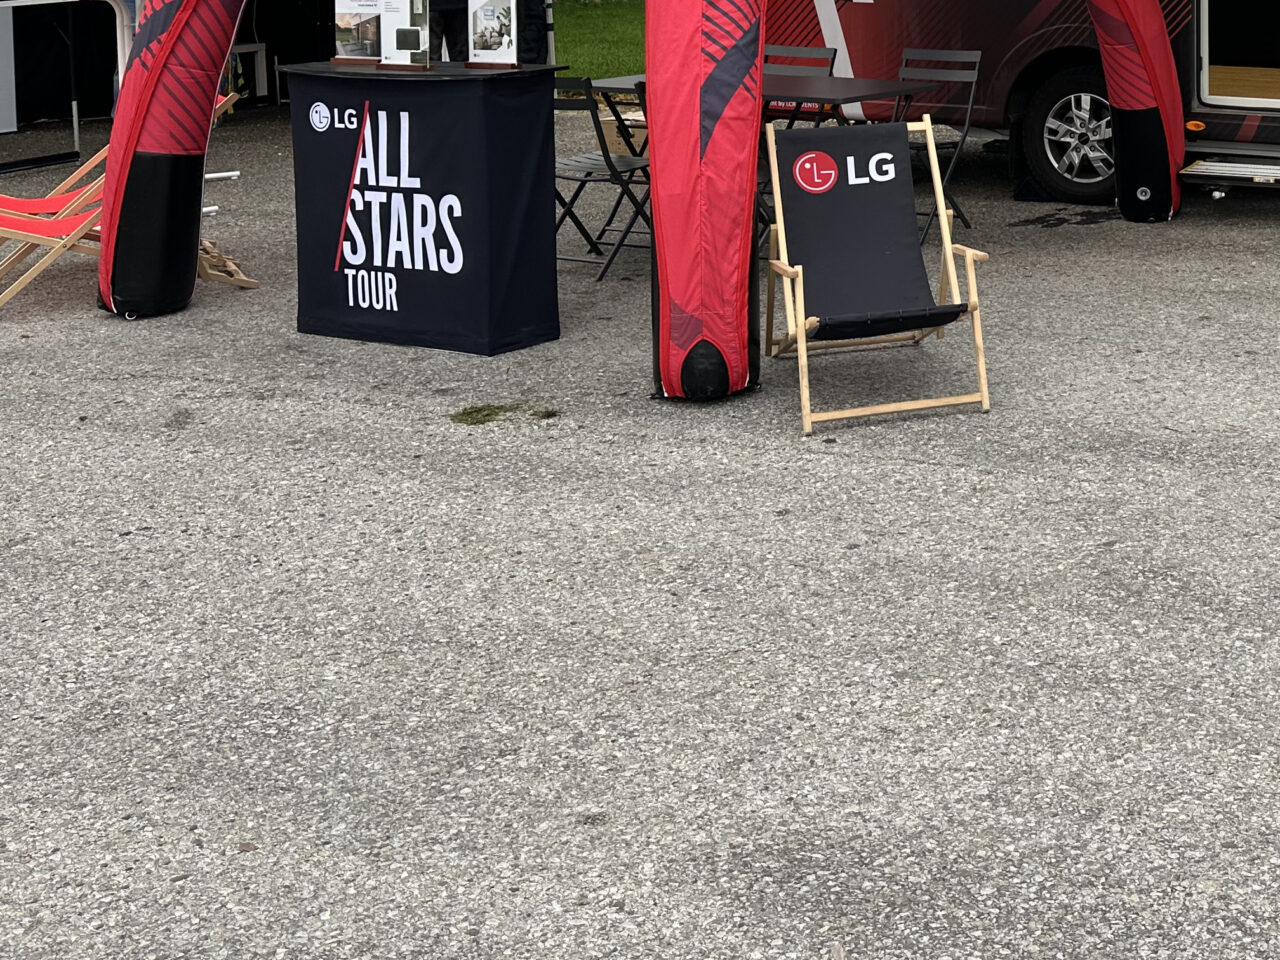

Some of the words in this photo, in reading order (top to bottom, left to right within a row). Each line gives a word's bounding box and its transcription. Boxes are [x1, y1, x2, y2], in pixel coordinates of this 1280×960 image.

[333, 107, 358, 129] LG
[353, 110, 421, 188] ALL
[846, 152, 896, 185] LG
[342, 188, 464, 274] STARS
[343, 268, 399, 311] TOUR
